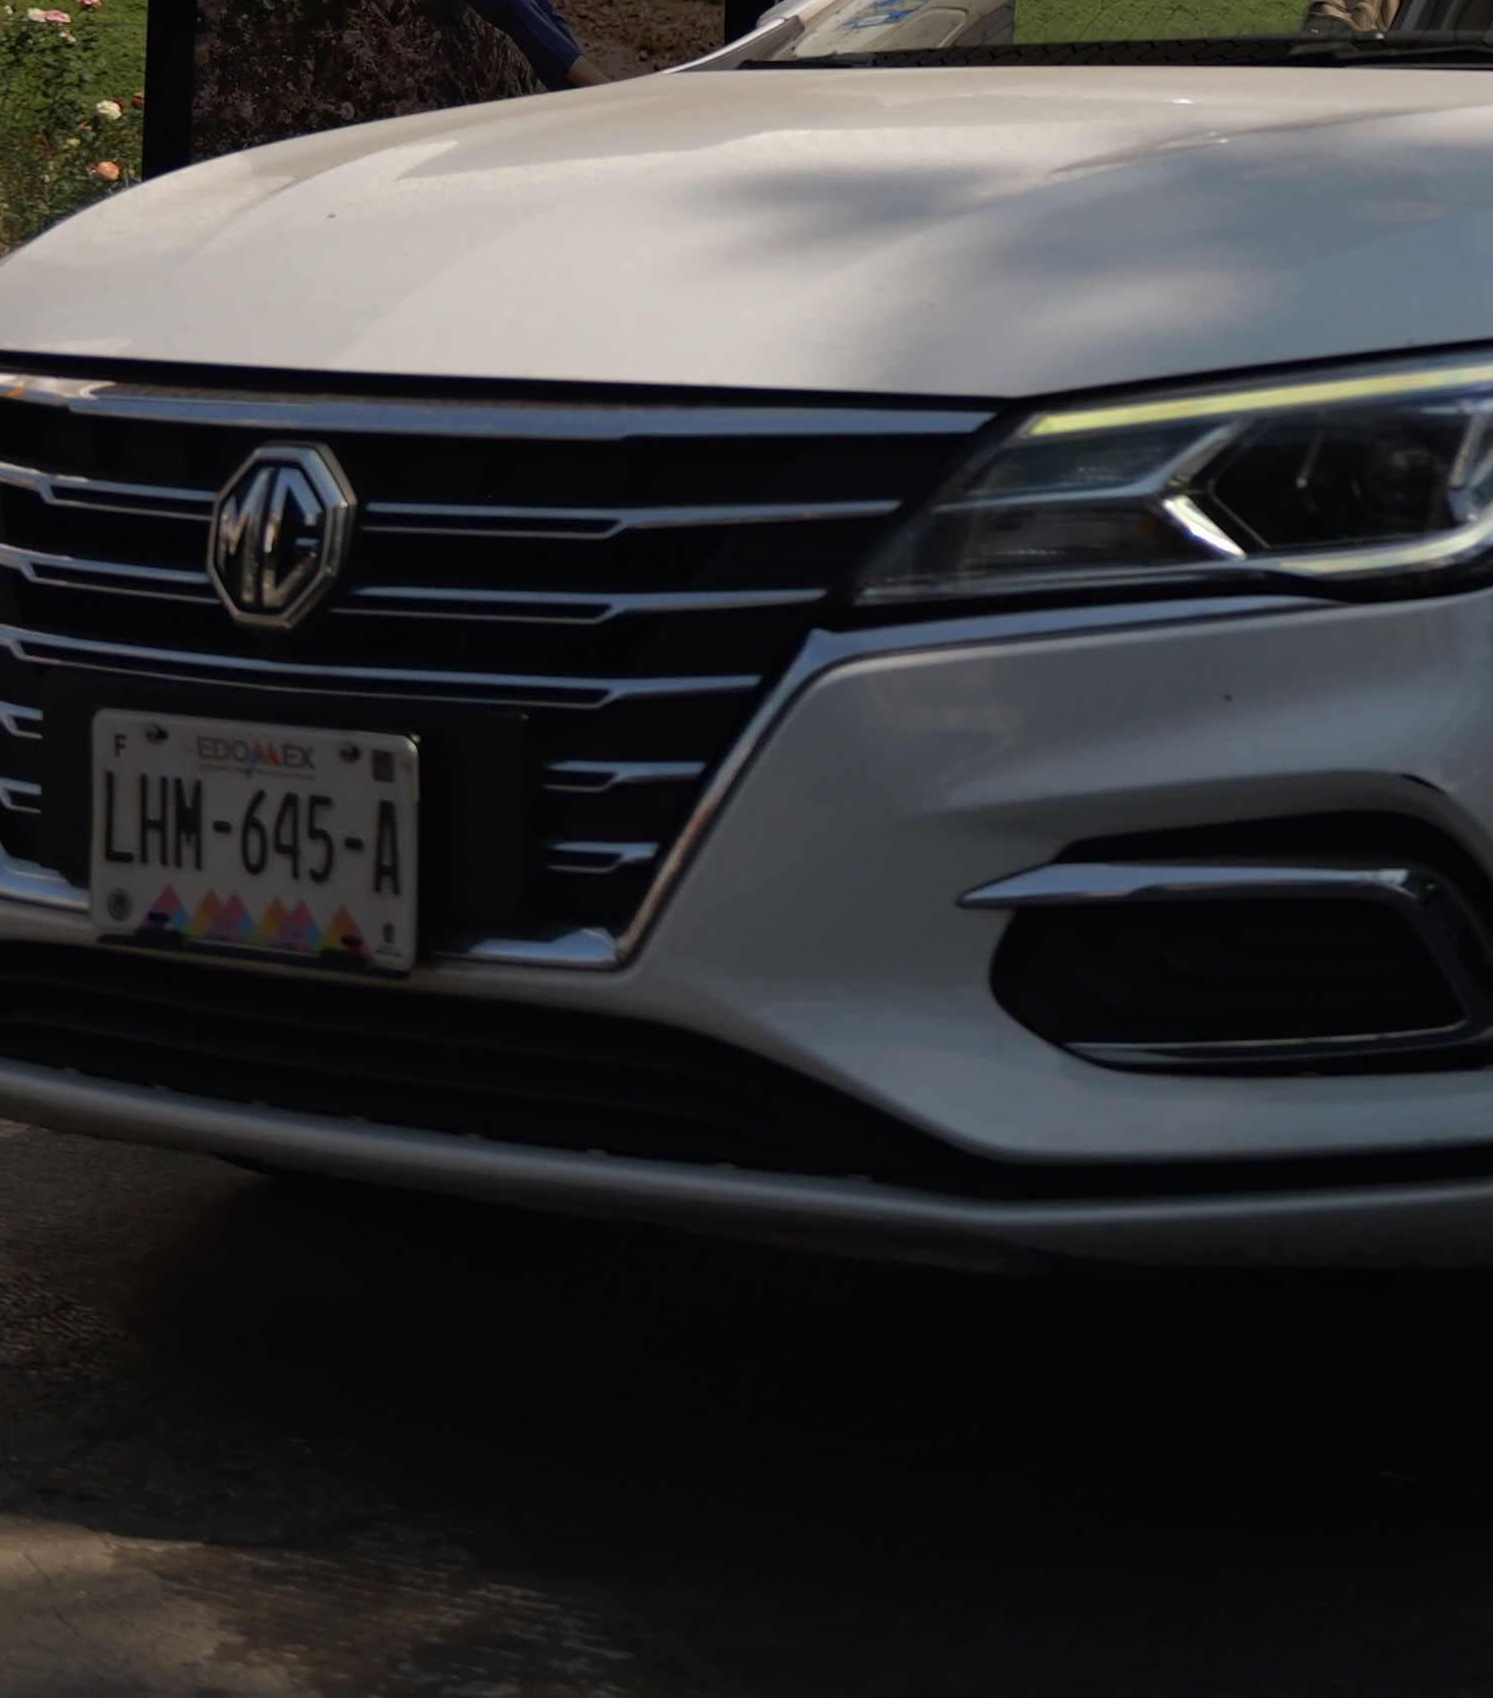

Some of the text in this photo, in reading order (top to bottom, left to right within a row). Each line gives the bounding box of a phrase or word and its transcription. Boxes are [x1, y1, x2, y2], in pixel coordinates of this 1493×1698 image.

[216, 465, 327, 608] MG
[114, 734, 126, 756] F
[104, 770, 401, 896] LHM-645-A
